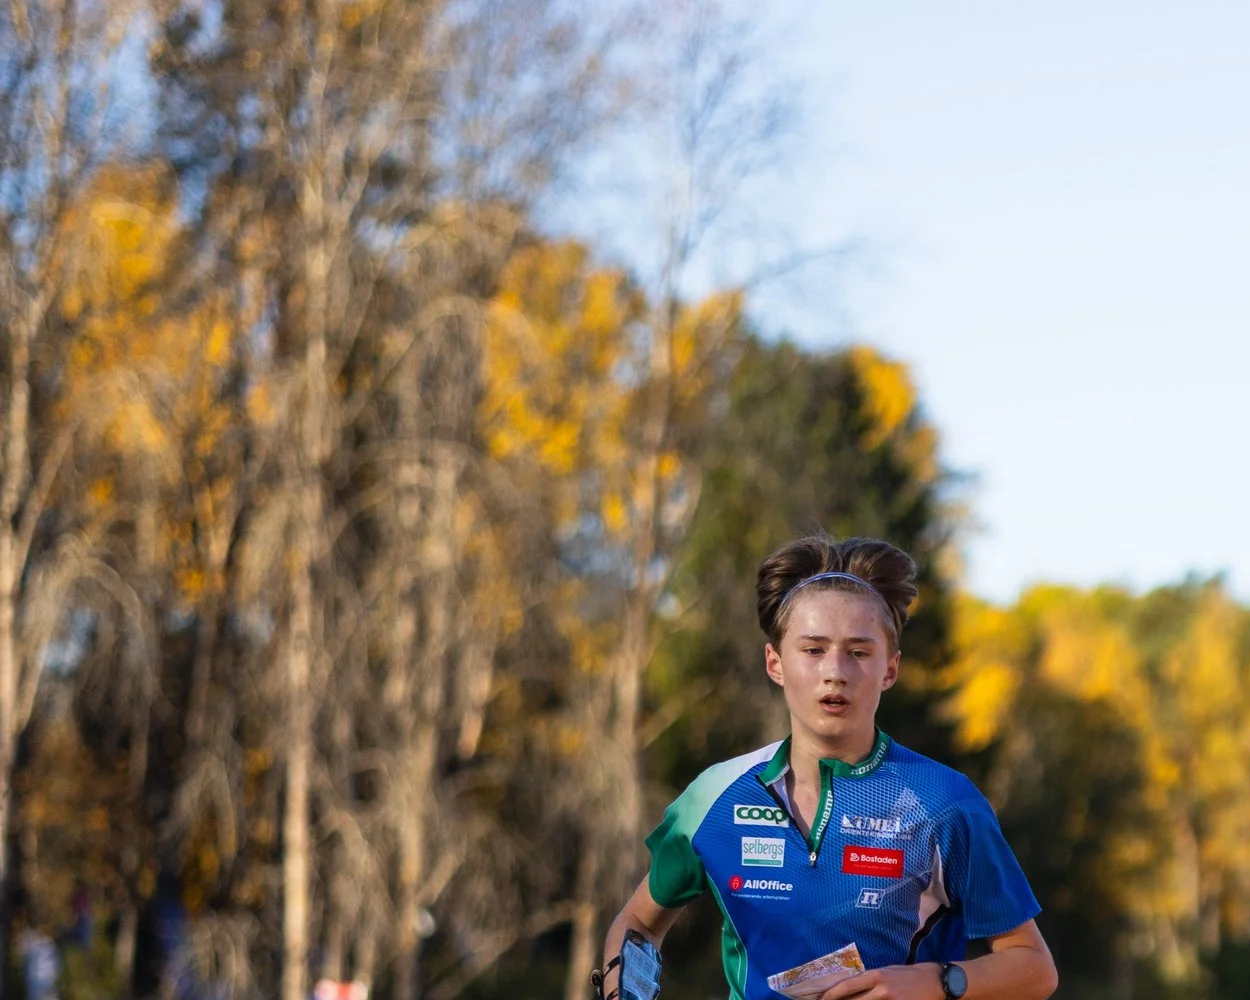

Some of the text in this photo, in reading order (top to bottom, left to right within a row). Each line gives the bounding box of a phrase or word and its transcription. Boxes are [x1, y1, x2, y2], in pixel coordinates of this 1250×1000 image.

[851, 742, 887, 775] noname
[736, 806, 788, 824] coop
[743, 839, 784, 859] selbergs
[860, 854, 898, 864] Bostaden
[743, 879, 793, 891] AllOffice
